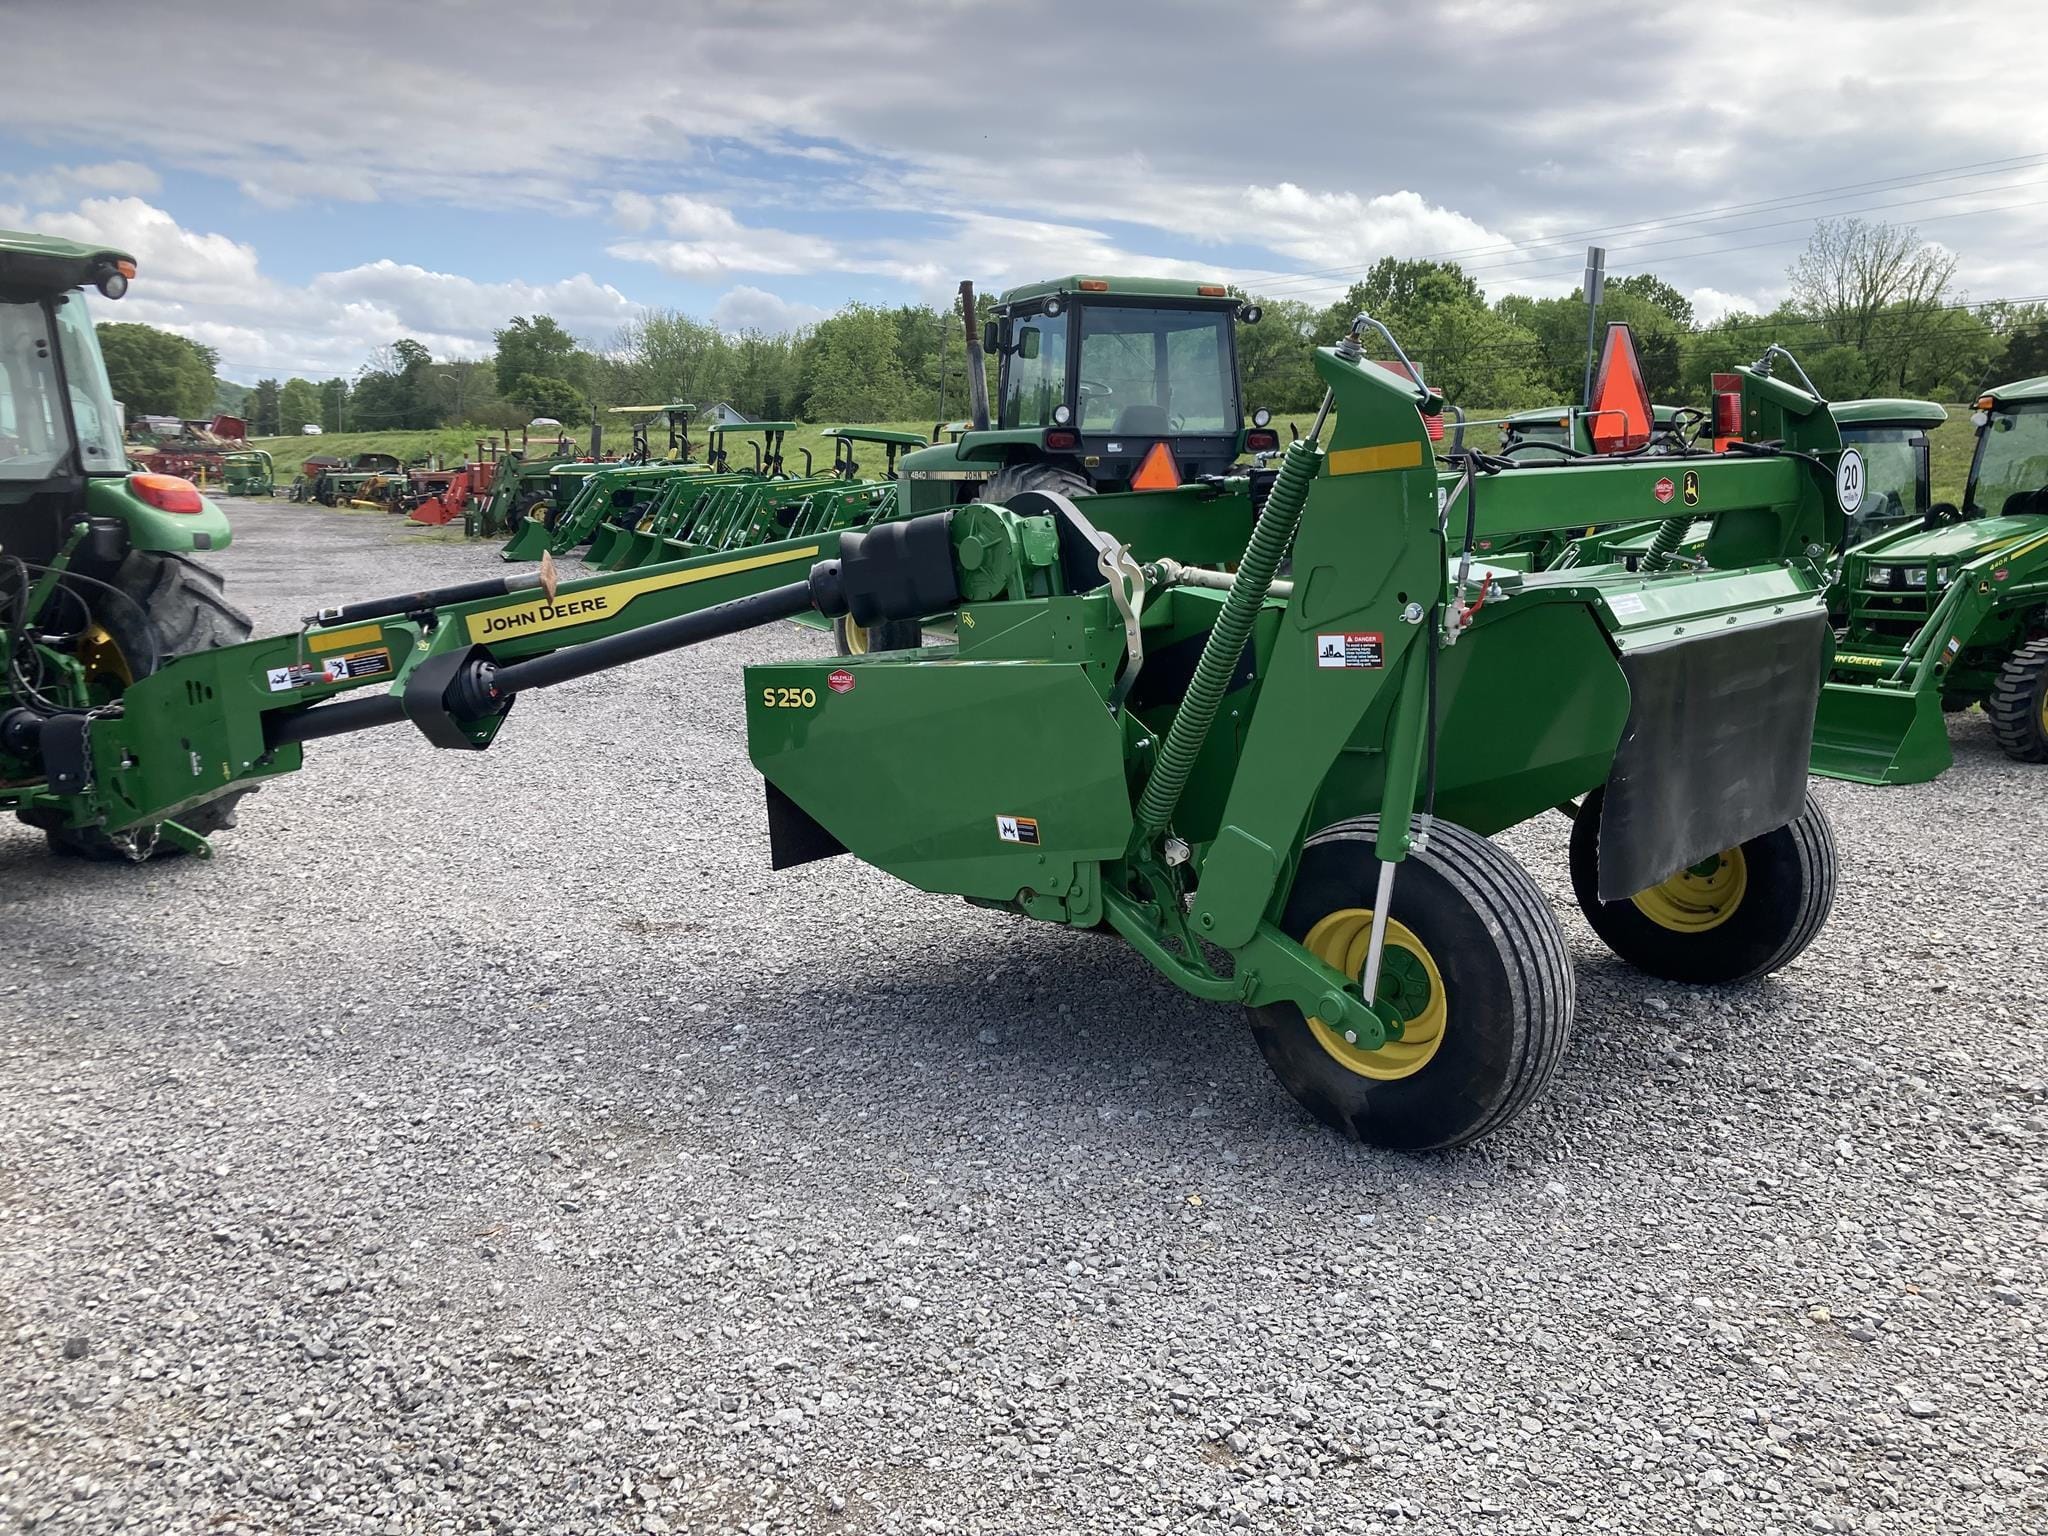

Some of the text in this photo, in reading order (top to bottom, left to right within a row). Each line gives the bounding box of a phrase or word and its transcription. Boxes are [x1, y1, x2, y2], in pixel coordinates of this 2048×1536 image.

[1844, 464, 1858, 491] 20
[482, 597, 607, 634] JOHN DEERE
[1847, 655, 1883, 666] DEERE
